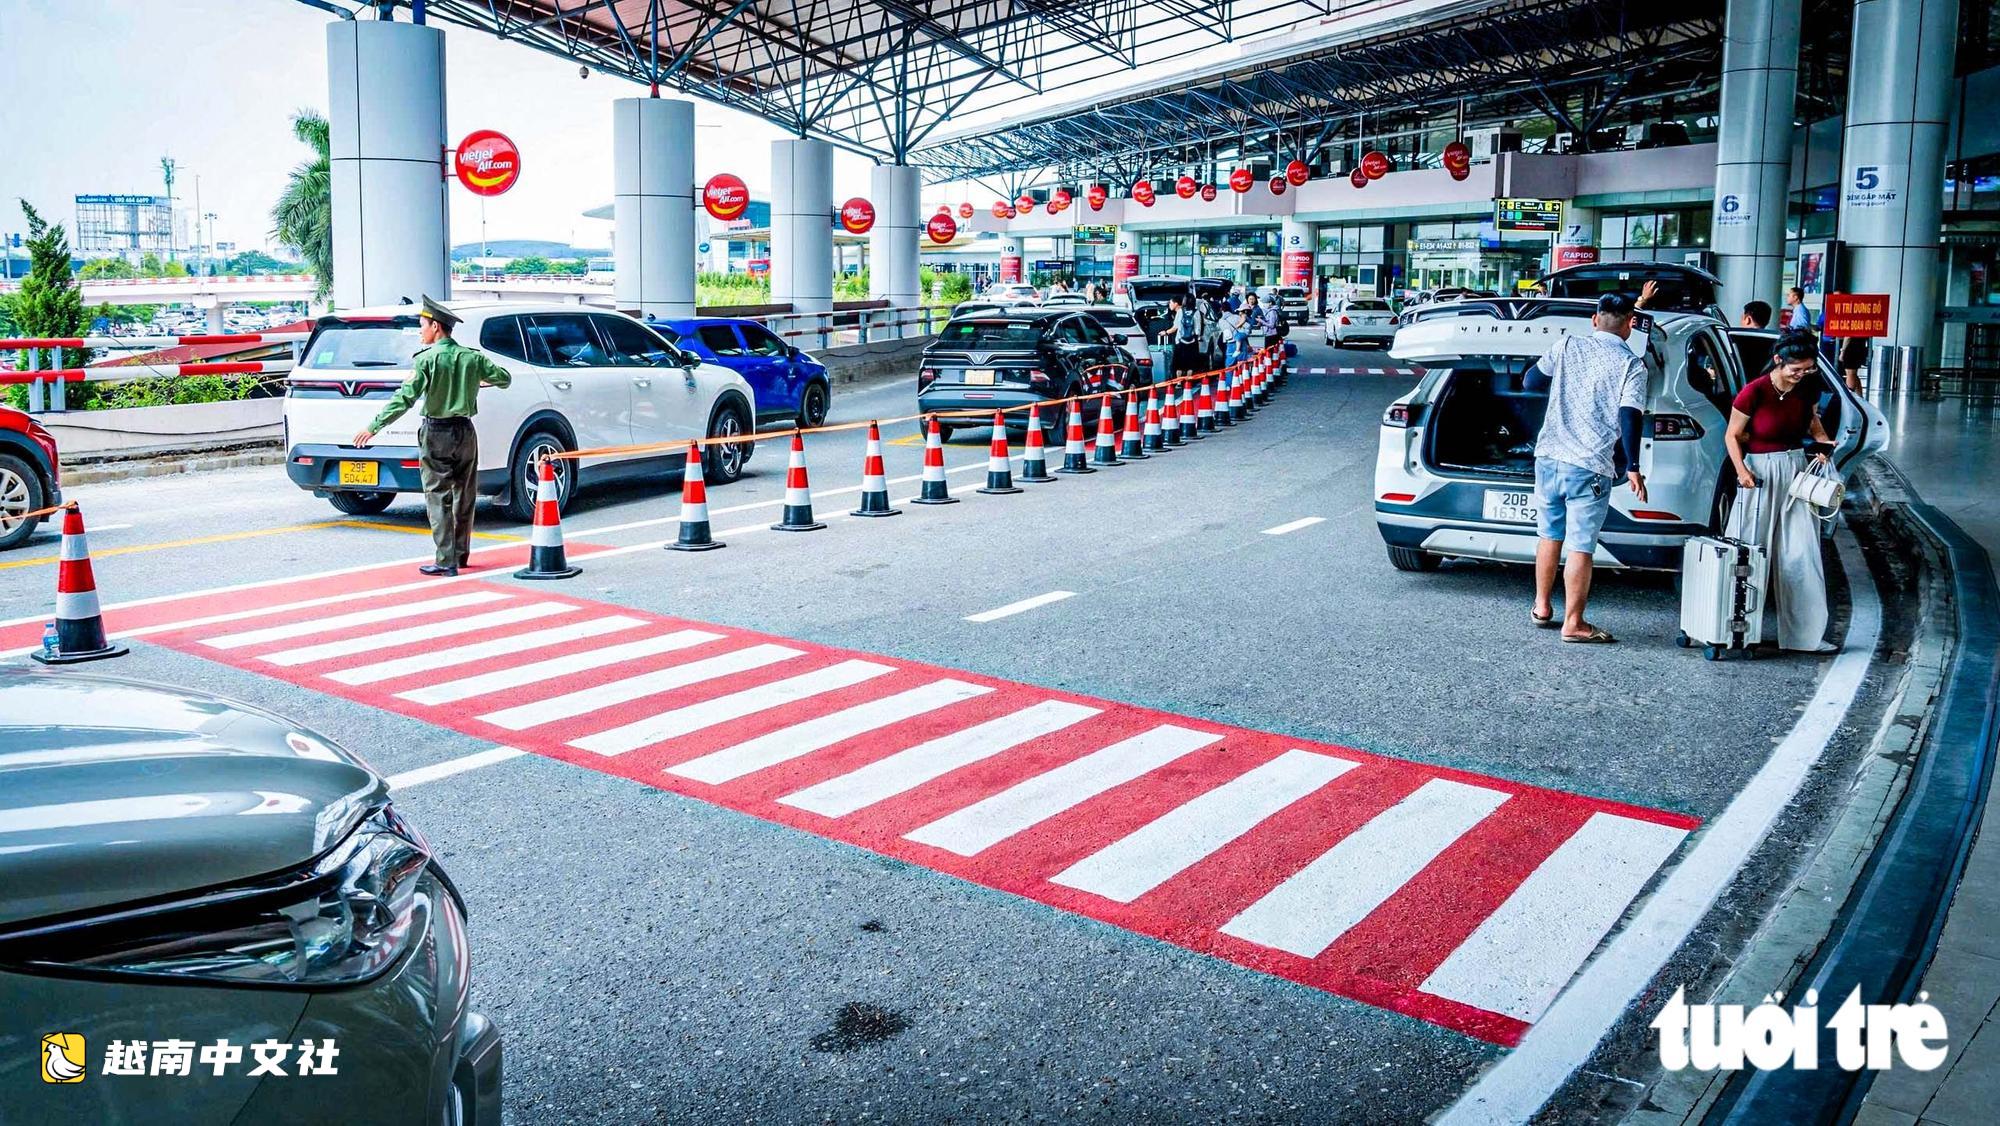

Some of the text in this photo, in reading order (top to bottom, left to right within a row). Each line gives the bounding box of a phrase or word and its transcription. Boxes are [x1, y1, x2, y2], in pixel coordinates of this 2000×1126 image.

[460, 148, 493, 165] Vietjet
[477, 160, 512, 173] Air.com
[1855, 166, 1879, 190] 5
[1515, 202, 1521, 210] E
[1537, 203, 1544, 211] A
[1721, 194, 1739, 213] 6
[1568, 225, 1581, 237] 7
[1119, 241, 1127, 249] 9
[1290, 235, 1300, 245] 8
[1562, 251, 1594, 259] RAPIDO
[1461, 325, 1567, 336] VINFAST
[350, 462, 367, 473] 29E
[1502, 493, 1529, 506] 20B
